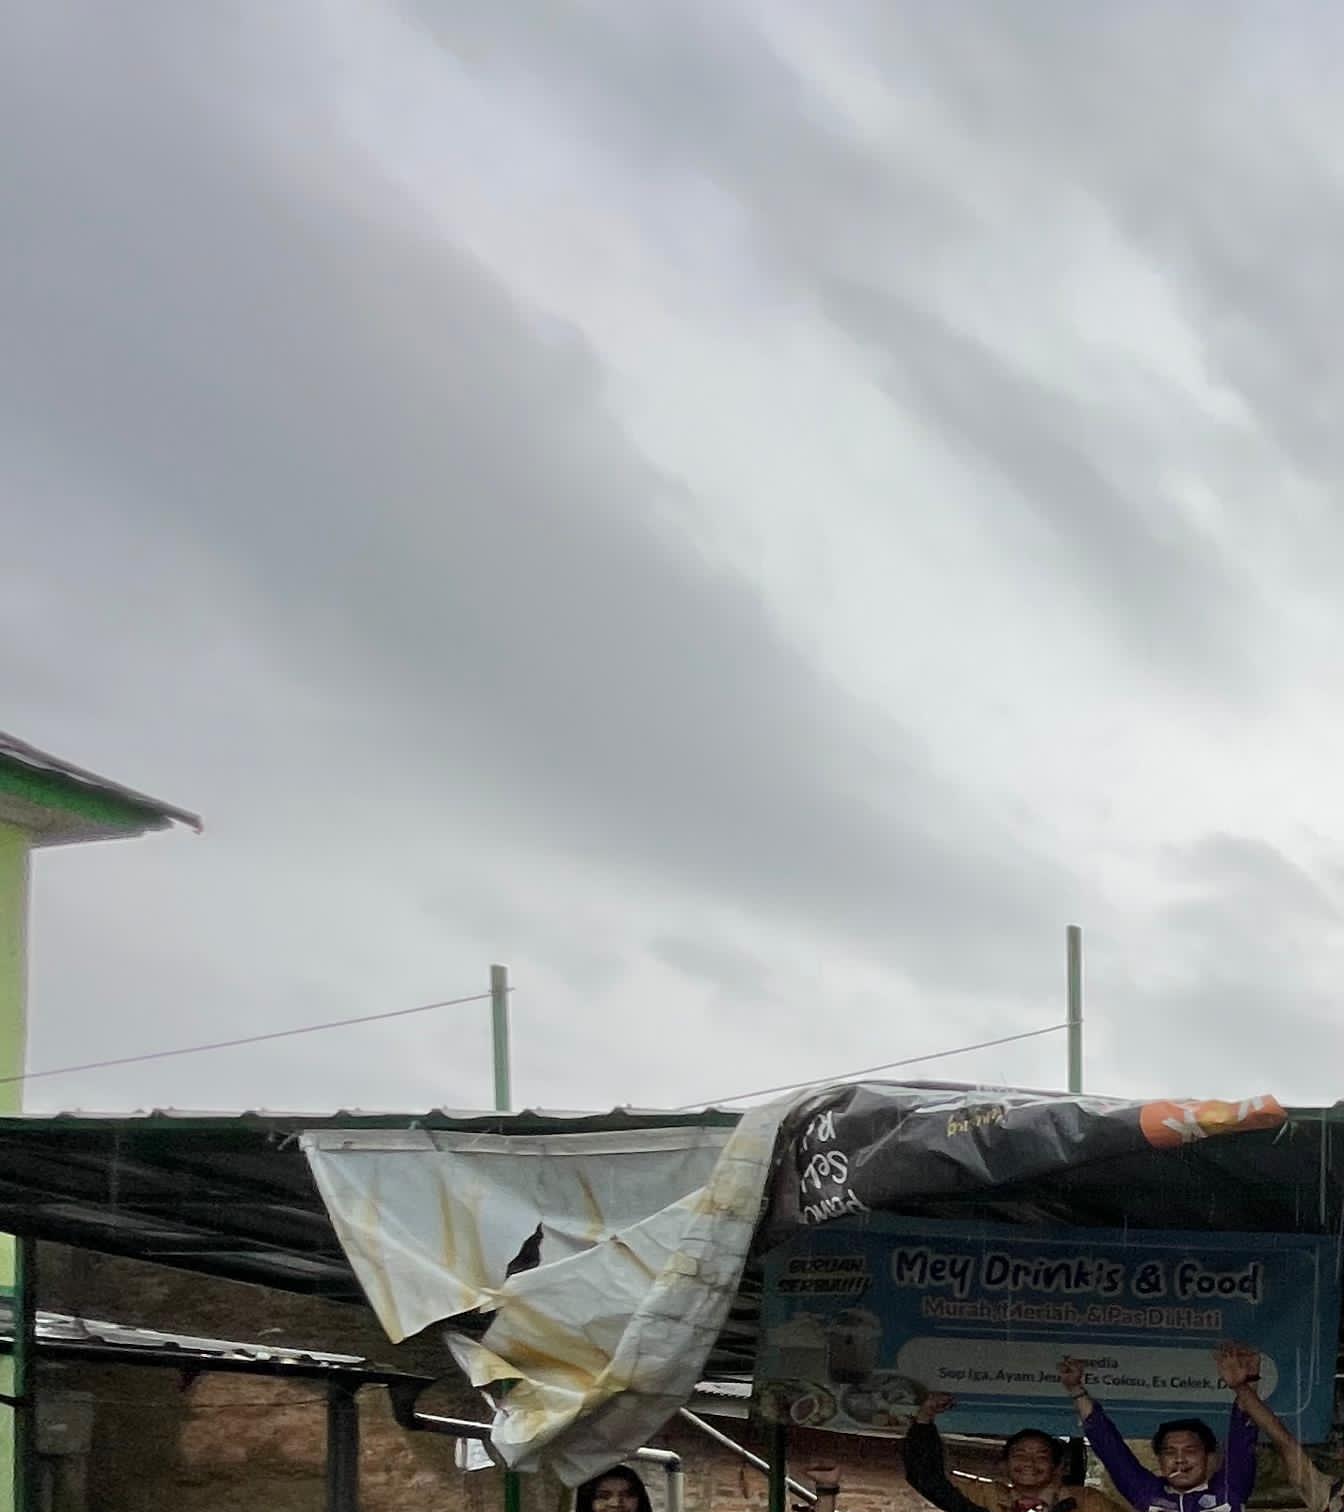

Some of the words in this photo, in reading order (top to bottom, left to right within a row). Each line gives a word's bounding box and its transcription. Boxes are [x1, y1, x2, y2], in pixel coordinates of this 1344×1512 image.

[895, 1248, 972, 1296] Mey
[1134, 1262, 1163, 1295] &
[1088, 1304, 1103, 1324] &
[1107, 1305, 1145, 1326] Pas
[1176, 1308, 1221, 1328] Hati
[996, 1368, 1034, 1383] Ayam
[1084, 1373, 1099, 1385] Es
[1152, 1375, 1166, 1388] Es
